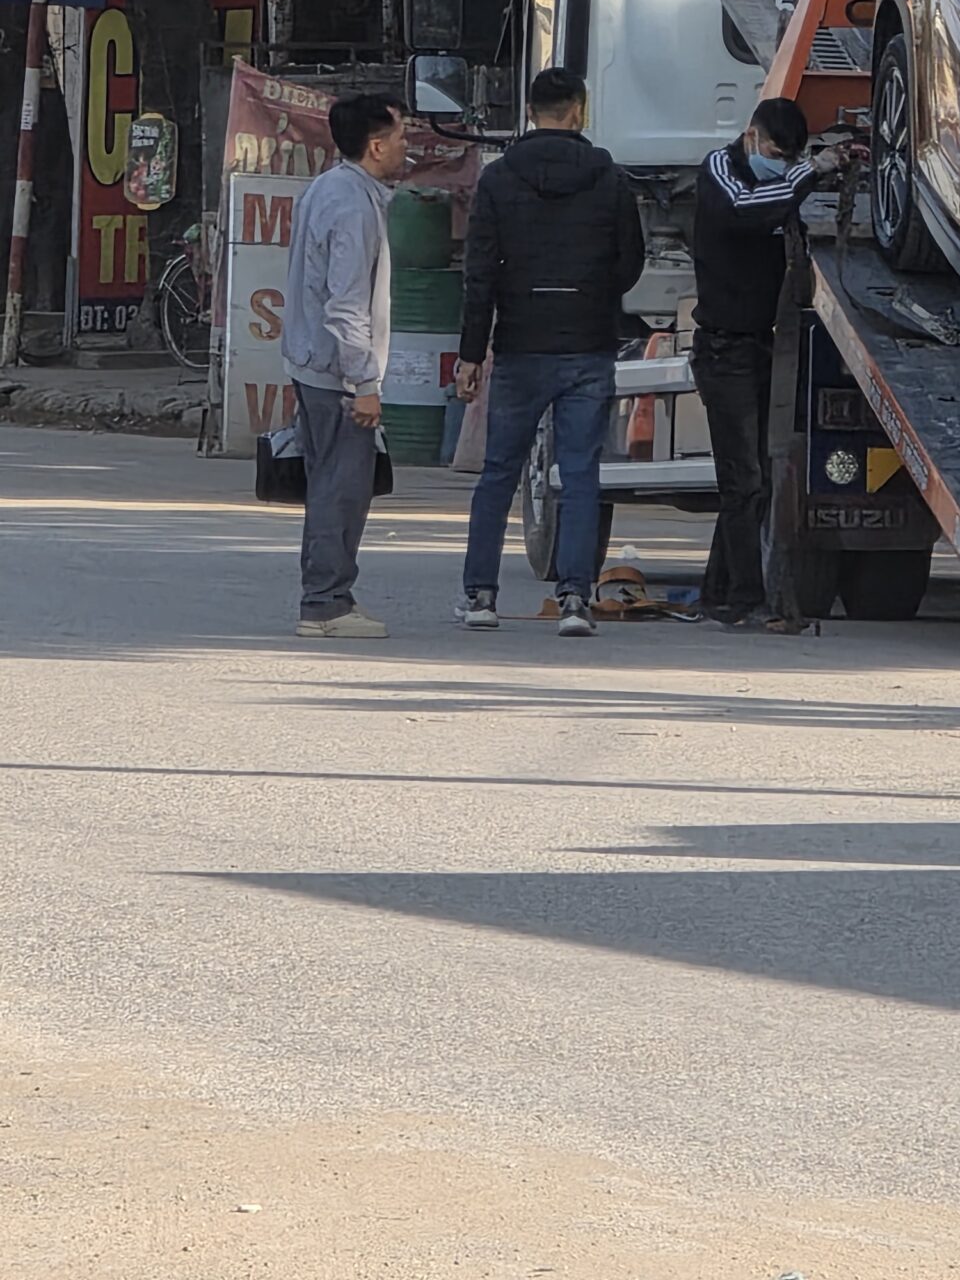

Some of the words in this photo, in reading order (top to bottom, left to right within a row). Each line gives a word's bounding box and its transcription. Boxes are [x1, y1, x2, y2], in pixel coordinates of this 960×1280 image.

[242, 193, 294, 248] M
[80, 305, 109, 331] ĐT:
[249, 288, 285, 342] S
[807, 509, 905, 529] ISUZU
